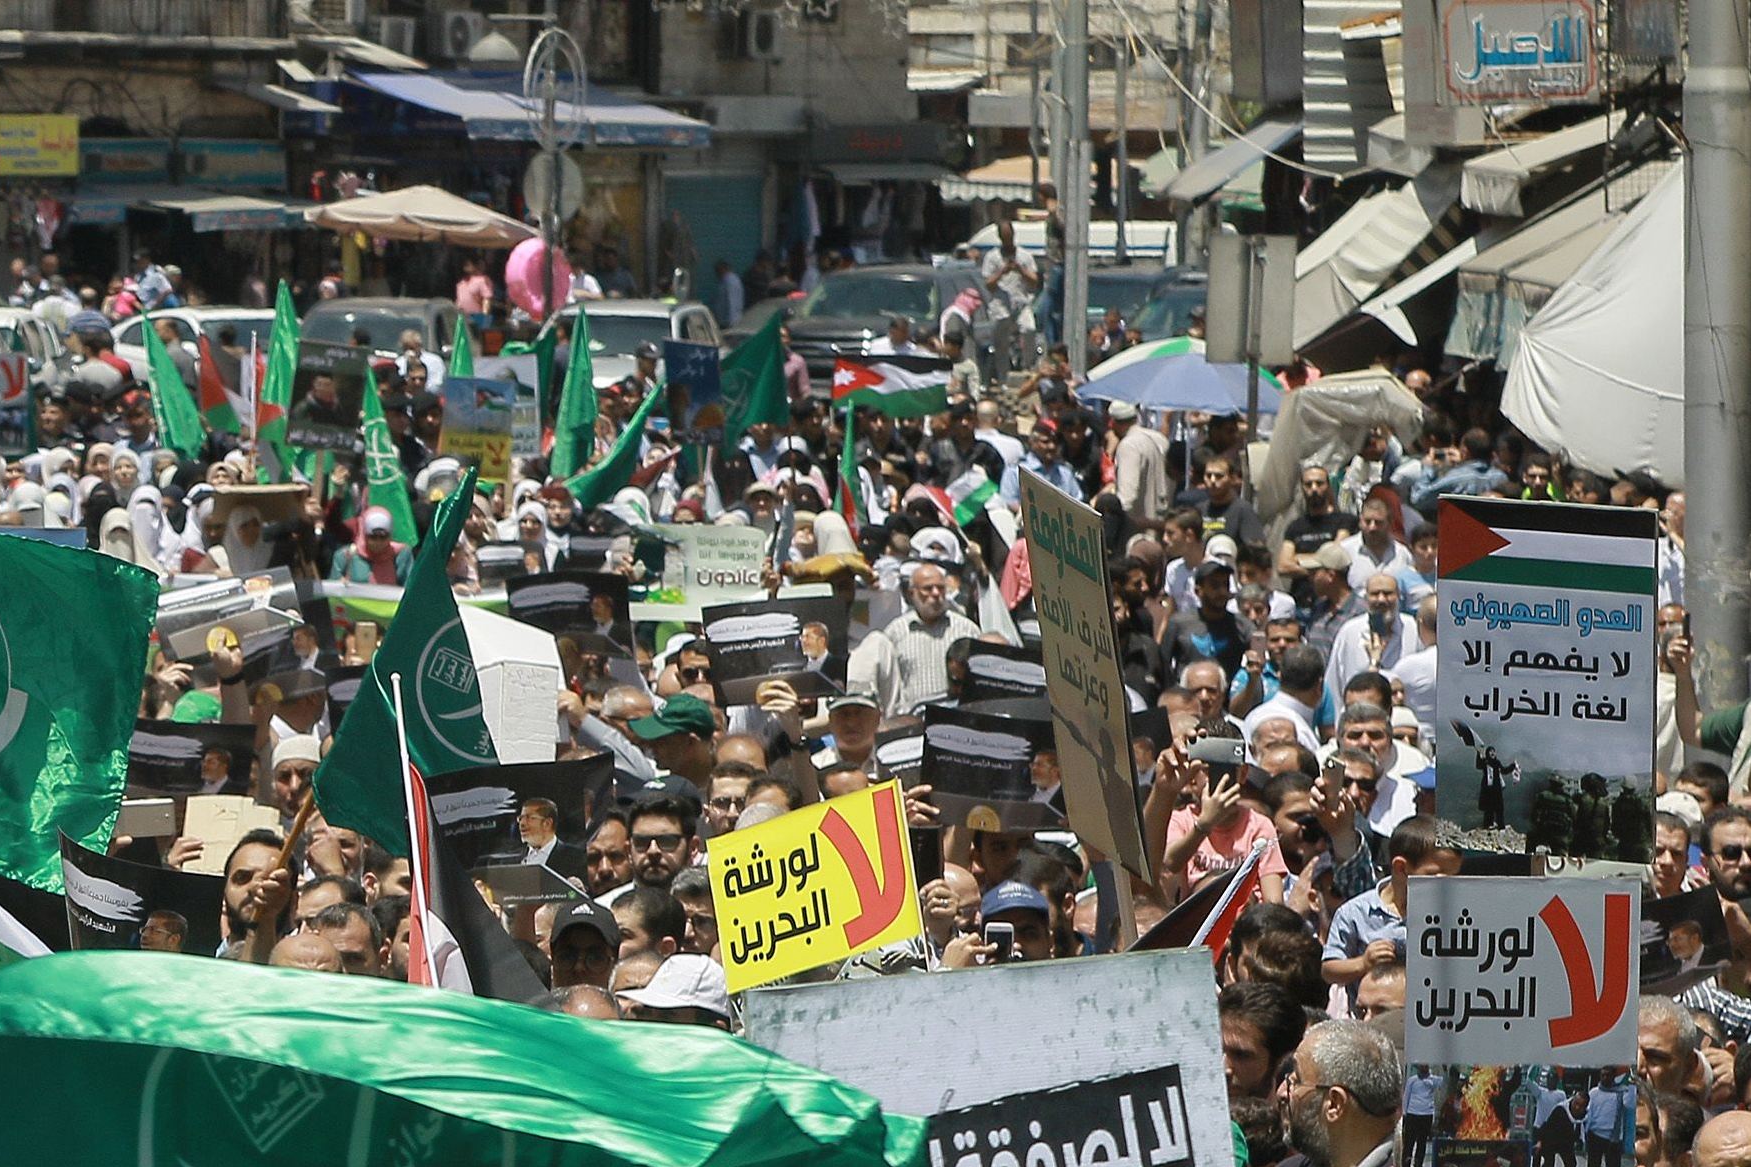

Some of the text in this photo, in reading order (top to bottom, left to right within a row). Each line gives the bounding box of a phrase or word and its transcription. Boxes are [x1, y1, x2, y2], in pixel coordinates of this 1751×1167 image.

[1027, 488, 1102, 586] المقاومة
[1041, 583, 1113, 662] شرف الأمة
[1450, 592, 1642, 637] العدو الصهيوني
[1057, 643, 1109, 721] وعزتها
[1462, 640, 1631, 681] لا يفهم إلا
[1464, 687, 1627, 721] لغة الخراب
[724, 832, 820, 898] لورشة
[818, 786, 906, 950] لا
[730, 888, 831, 965] البحرين
[1420, 908, 1535, 973] لورشة
[1416, 976, 1536, 1033] البحرين
[1538, 894, 1632, 1048] لا
